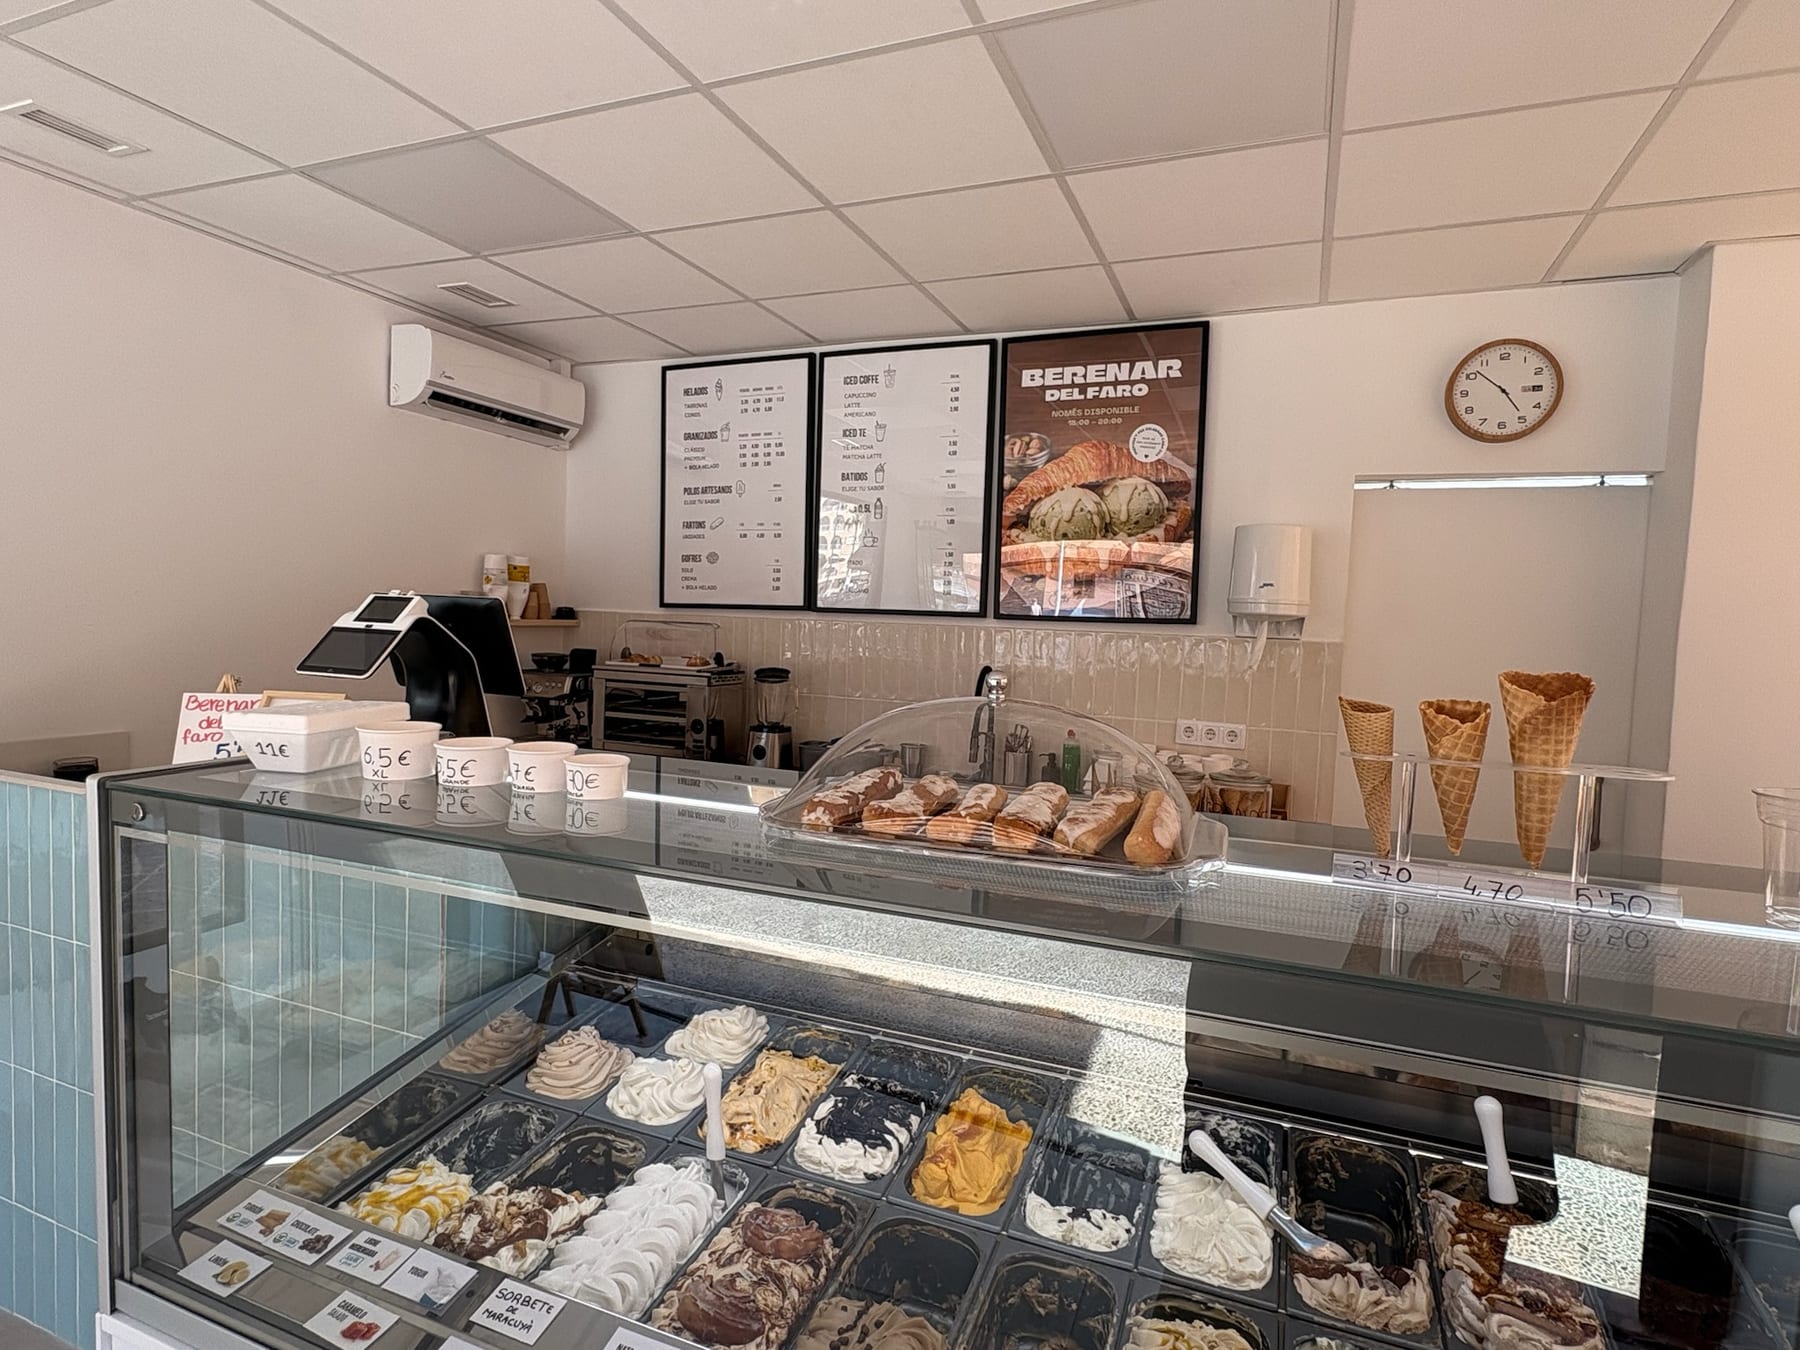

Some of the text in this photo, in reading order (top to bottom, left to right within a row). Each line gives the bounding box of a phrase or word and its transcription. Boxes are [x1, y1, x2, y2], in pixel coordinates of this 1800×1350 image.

[1499, 352, 1511, 361] 12
[1480, 359, 1488, 368] 11
[1021, 359, 1183, 388] BERENAR
[1465, 372, 1478, 380] 10
[1534, 367, 1544, 376] 2
[843, 374, 880, 386] ICED COFFE
[684, 386, 708, 396] HELADOS
[1045, 383, 1150, 402] DEL FARO
[1460, 390, 1469, 398] 9
[1051, 406, 1140, 418] NOMÉS DISPONIBLE
[1464, 406, 1474, 414] 8
[1478, 418, 1488, 426] 7
[1517, 416, 1527, 424] 5
[1497, 422, 1507, 430] 6
[684, 430, 718, 440] GRANIZADOS
[842, 428, 866, 438] ICED TE
[841, 472, 868, 482] BATIDOS
[684, 486, 732, 496] POLOS ARTESANOS
[682, 520, 706, 530] FARTONS
[681, 554, 702, 563] GOFRES
[184, 695, 261, 712] Berenar
[198, 716, 223, 730] del
[182, 729, 224, 745] faro
[255, 742, 290, 758] 11€
[372, 769, 389, 779] XL
[1463, 875, 1524, 901] 4,70
[1574, 886, 1652, 919] 5'50
[495, 1287, 554, 1314] SORBETE
[337, 1300, 368, 1320] CARAMELO
